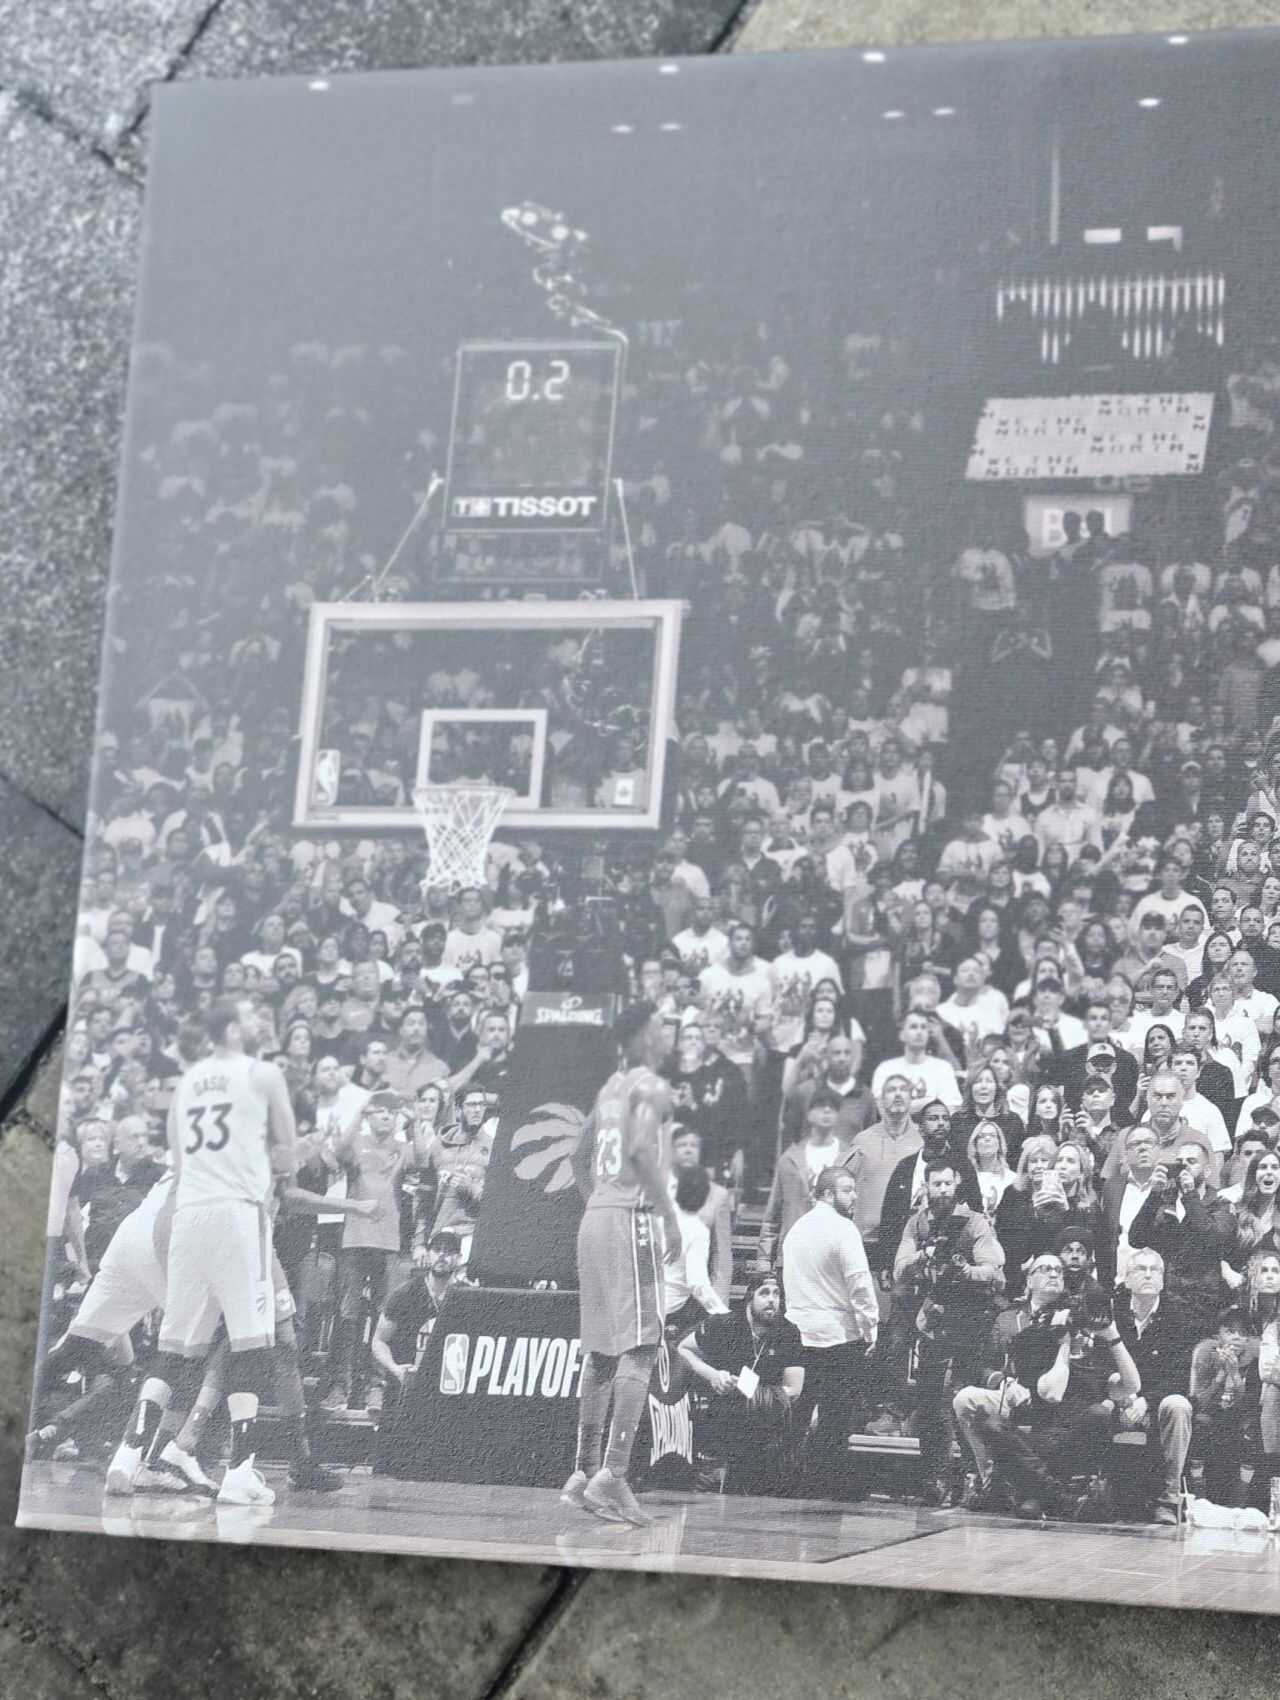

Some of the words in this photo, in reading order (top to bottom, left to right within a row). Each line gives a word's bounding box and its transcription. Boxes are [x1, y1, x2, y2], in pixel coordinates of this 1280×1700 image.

[506, 360, 570, 401] 0.2
[494, 496, 597, 516] TISSOT
[185, 1101, 233, 1154] 33
[466, 1335, 583, 1398] PLAYOF
